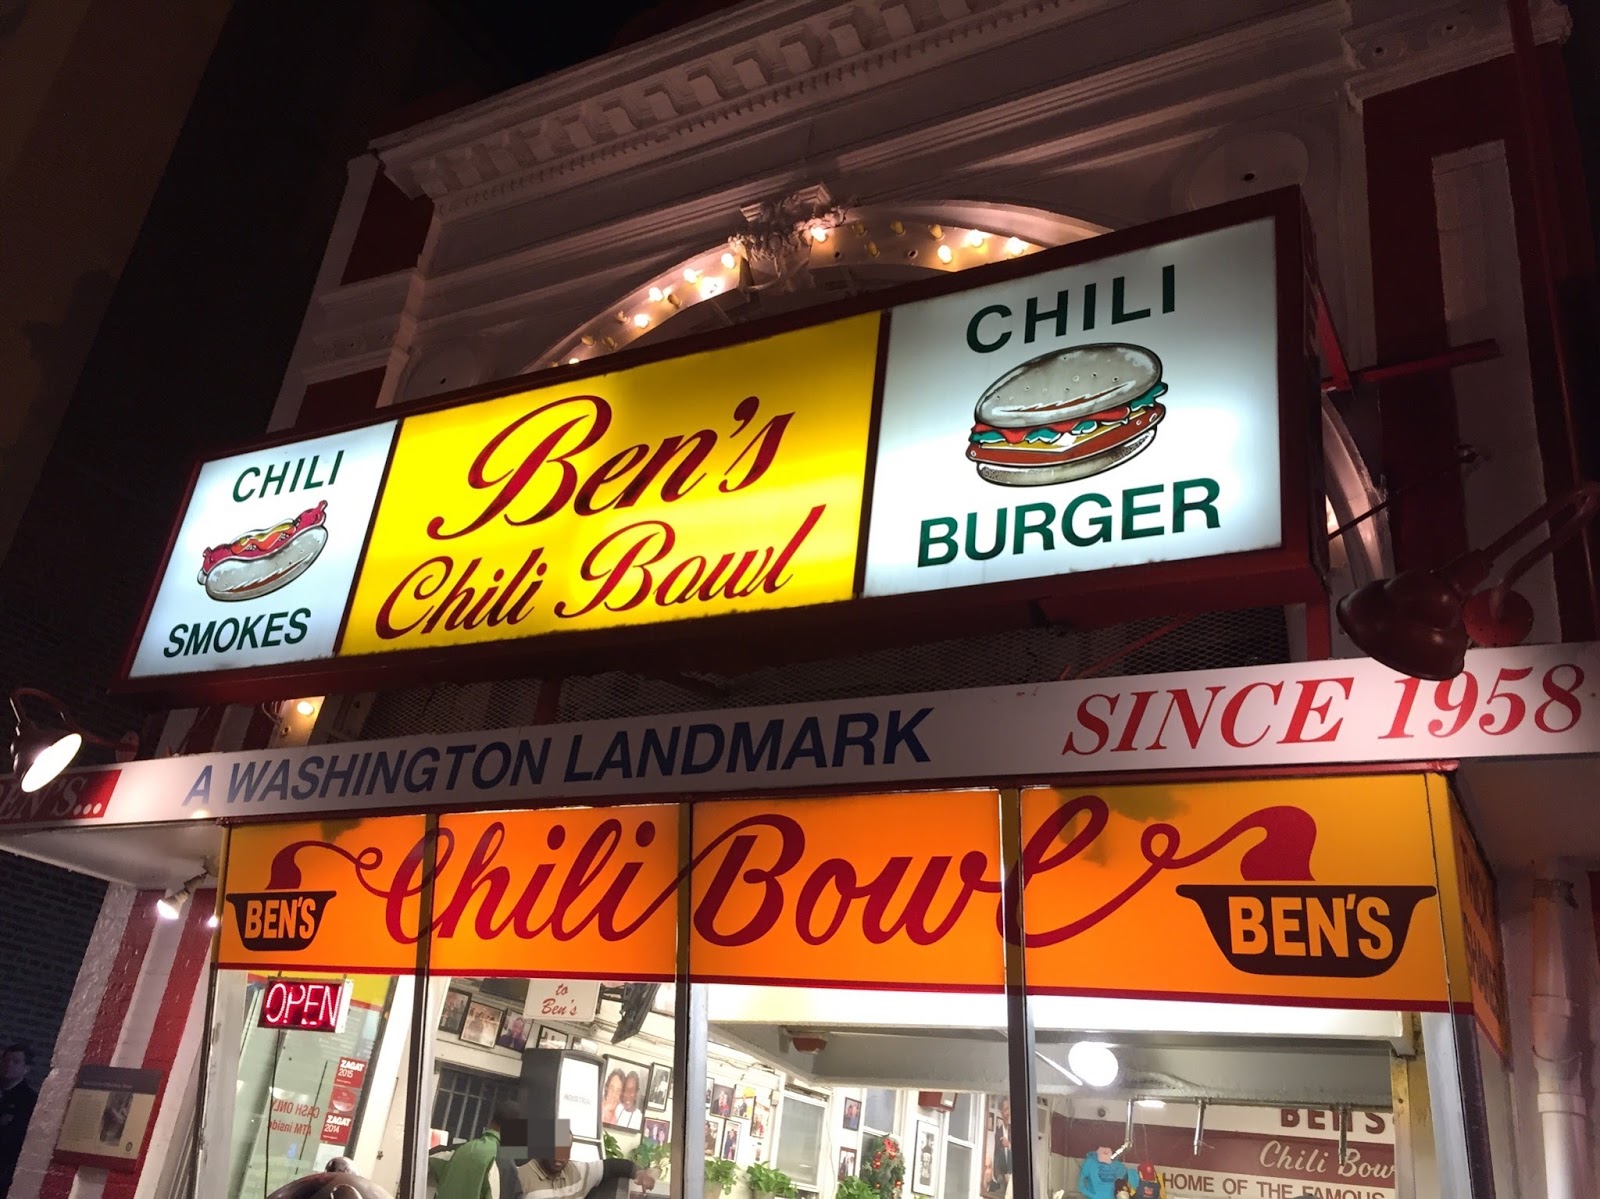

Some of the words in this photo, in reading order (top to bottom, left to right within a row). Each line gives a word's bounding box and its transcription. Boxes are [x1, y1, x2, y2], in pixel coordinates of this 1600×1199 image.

[965, 263, 1176, 354] CHILI
[232, 449, 345, 503] CHILI
[426, 394, 796, 540] Ben's
[916, 477, 1222, 568] BURGER
[375, 547, 548, 640] Chili
[554, 503, 827, 619] Bowl
[162, 607, 312, 658] SMOKES
[1061, 676, 1355, 756] SINCE
[1377, 662, 1586, 740] 1958
[181, 764, 213, 807] A
[226, 736, 552, 804] WASHINGTON
[563, 706, 936, 783] LANDMARK
[382, 817, 680, 945] Chili
[692, 795, 1110, 950] Bowl
[244, 895, 317, 940] BEN'S
[1226, 892, 1395, 961] BEN'S
[265, 982, 343, 1027] OPEN
[541, 997, 578, 1017] Ben's
[555, 983, 569, 996] to
[340, 1059, 365, 1072] ZAGAT
[326, 1114, 352, 1127] ZAGAT
[1259, 1139, 1329, 1174] Chili
[1337, 1147, 1396, 1179] Bow
[1163, 1172, 1215, 1193] HOME
[1222, 1177, 1249, 1196] OF
[1256, 1180, 1293, 1199] THE
